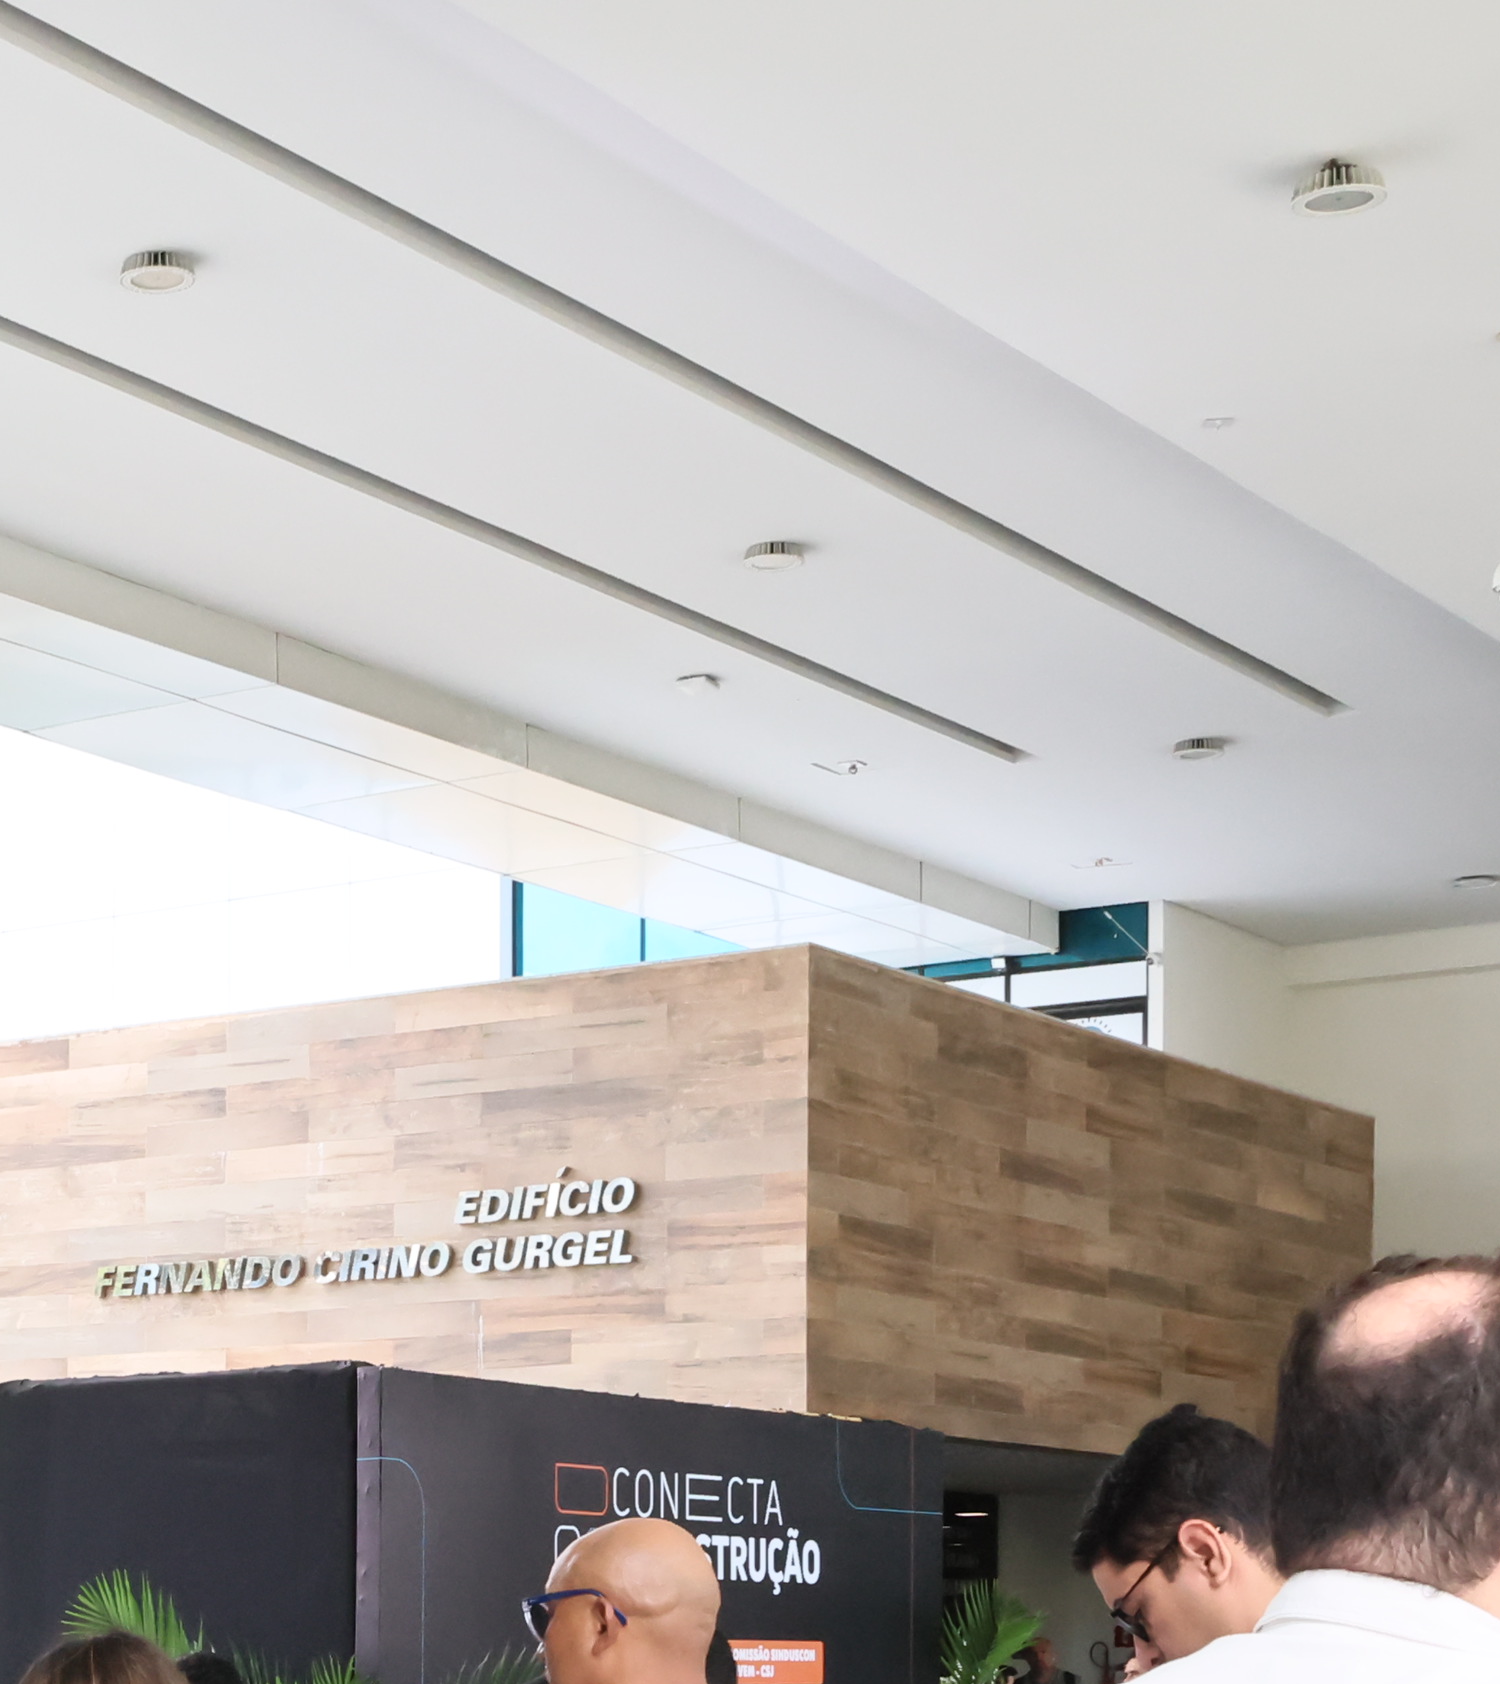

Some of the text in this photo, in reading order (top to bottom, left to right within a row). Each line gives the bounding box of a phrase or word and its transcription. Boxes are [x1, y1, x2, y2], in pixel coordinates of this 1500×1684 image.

[454, 1166, 637, 1226] EDIFÍCIO
[94, 1229, 635, 1298] FERNANDO CIRINO GURGEL
[612, 1467, 783, 1526] CONECTA
[770, 1648, 816, 1662] SINDUSCON
